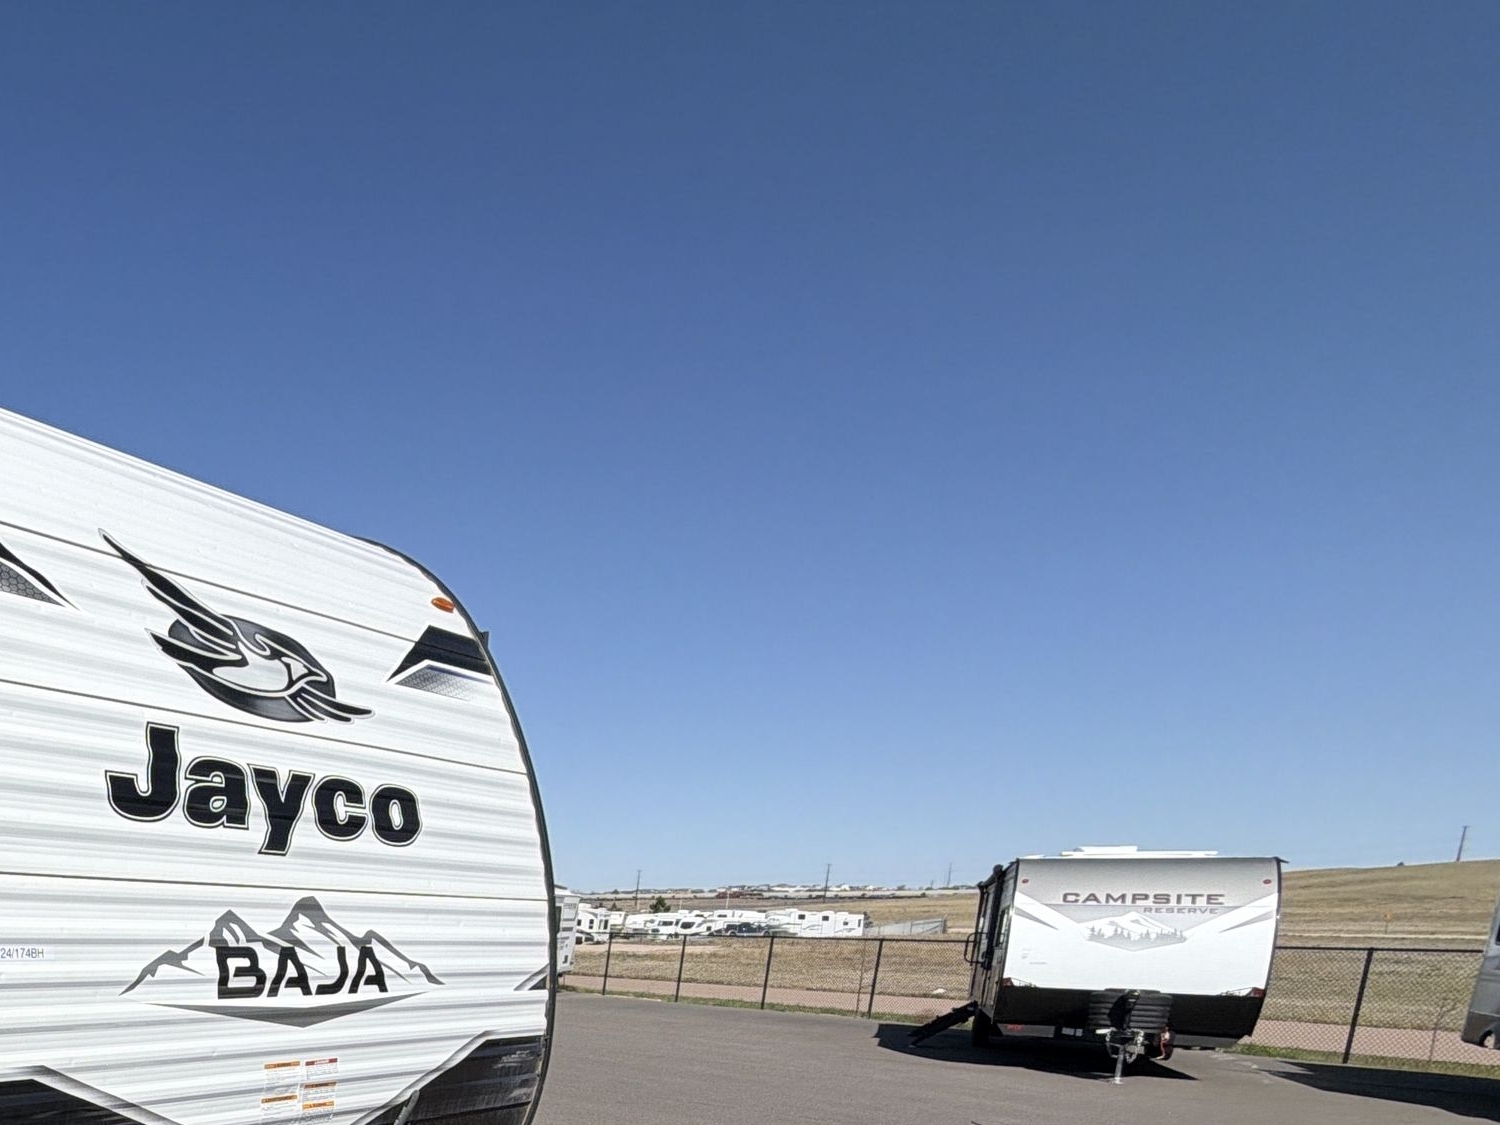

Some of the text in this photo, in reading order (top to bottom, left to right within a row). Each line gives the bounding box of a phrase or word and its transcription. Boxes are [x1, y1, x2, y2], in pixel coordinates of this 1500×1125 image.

[105, 721, 423, 856] Jayco
[1062, 892, 1225, 906] CAMPSITE
[1143, 907, 1220, 915] RESERVE
[215, 945, 389, 1000] BAJA
